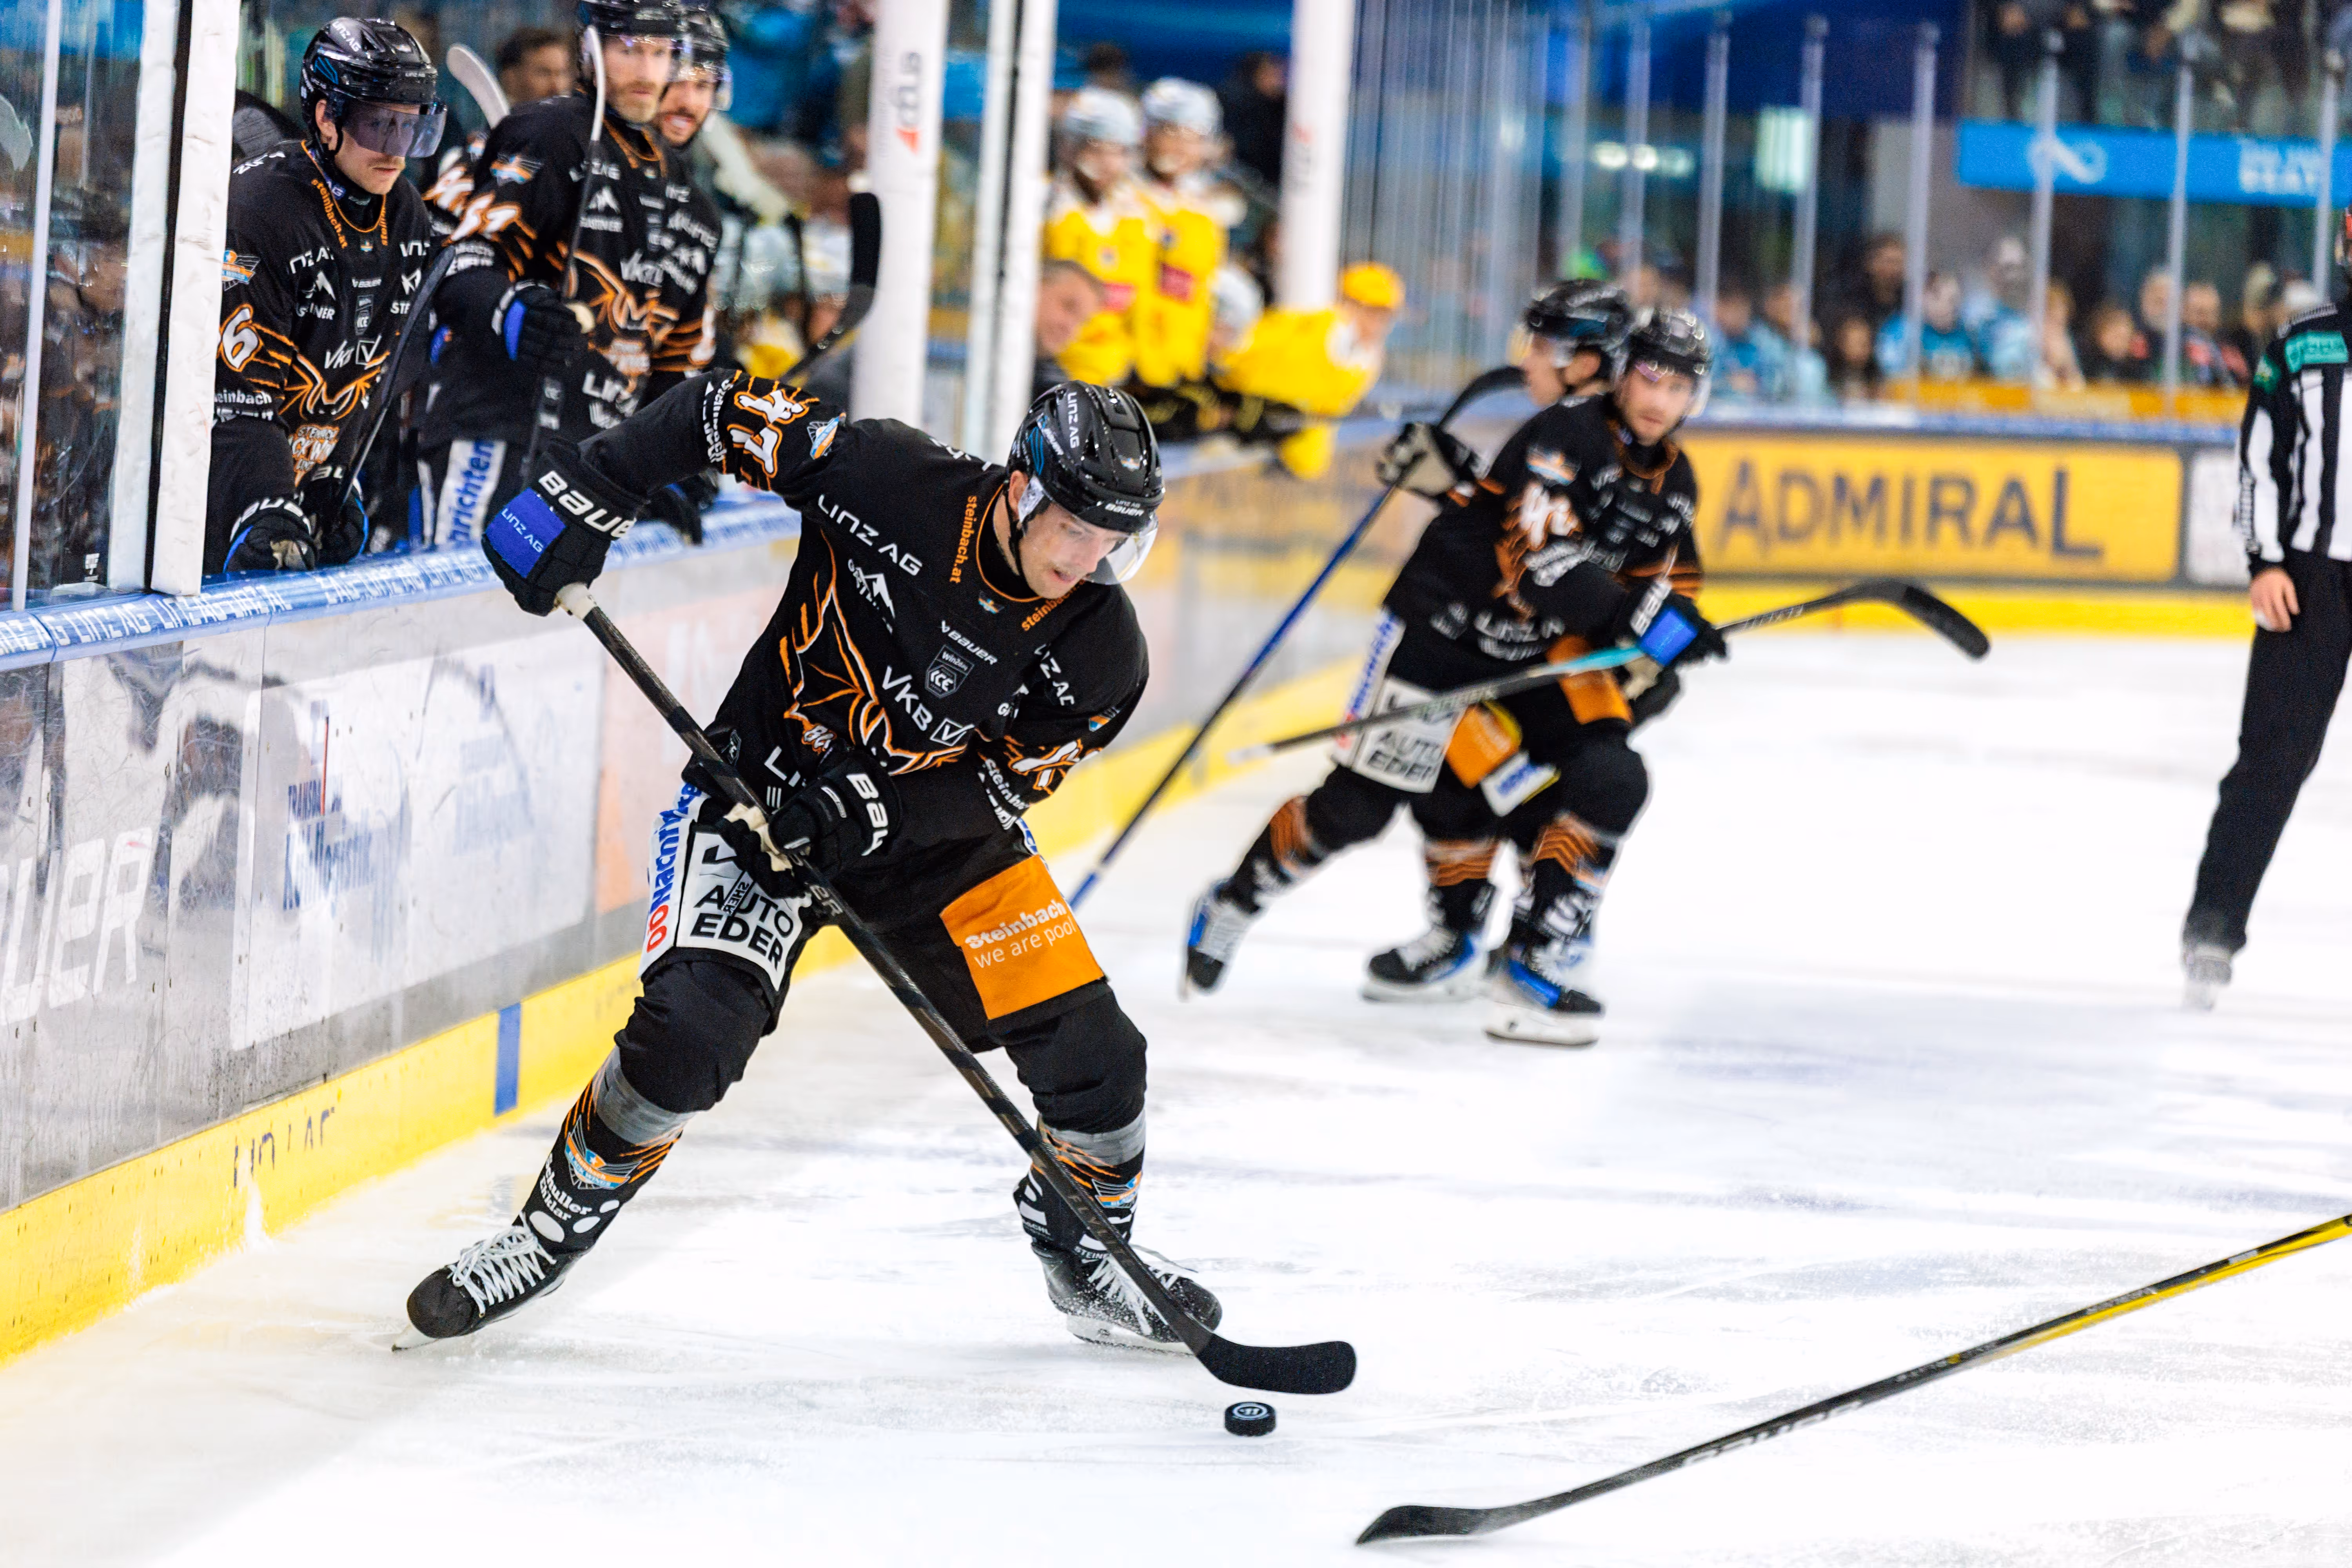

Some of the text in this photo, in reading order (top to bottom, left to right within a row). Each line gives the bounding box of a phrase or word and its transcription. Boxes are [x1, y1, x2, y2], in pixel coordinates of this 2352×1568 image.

[311, 178, 348, 249] steinbach.at
[1068, 391, 1080, 449] LINZ AG
[501, 508, 544, 553] LINZ AG
[818, 494, 923, 576] LINZ AG
[1719, 455, 2104, 564] ADMIRAL
[949, 495, 977, 584] steinbach.at
[948, 630, 998, 665] BAUER
[882, 665, 934, 731] VKB
[930, 669, 954, 691] ICE
[693, 885, 794, 939] AUTO
[965, 899, 1067, 950] Steinbach
[690, 912, 784, 972] EDER
[974, 916, 1077, 969] we are pool
